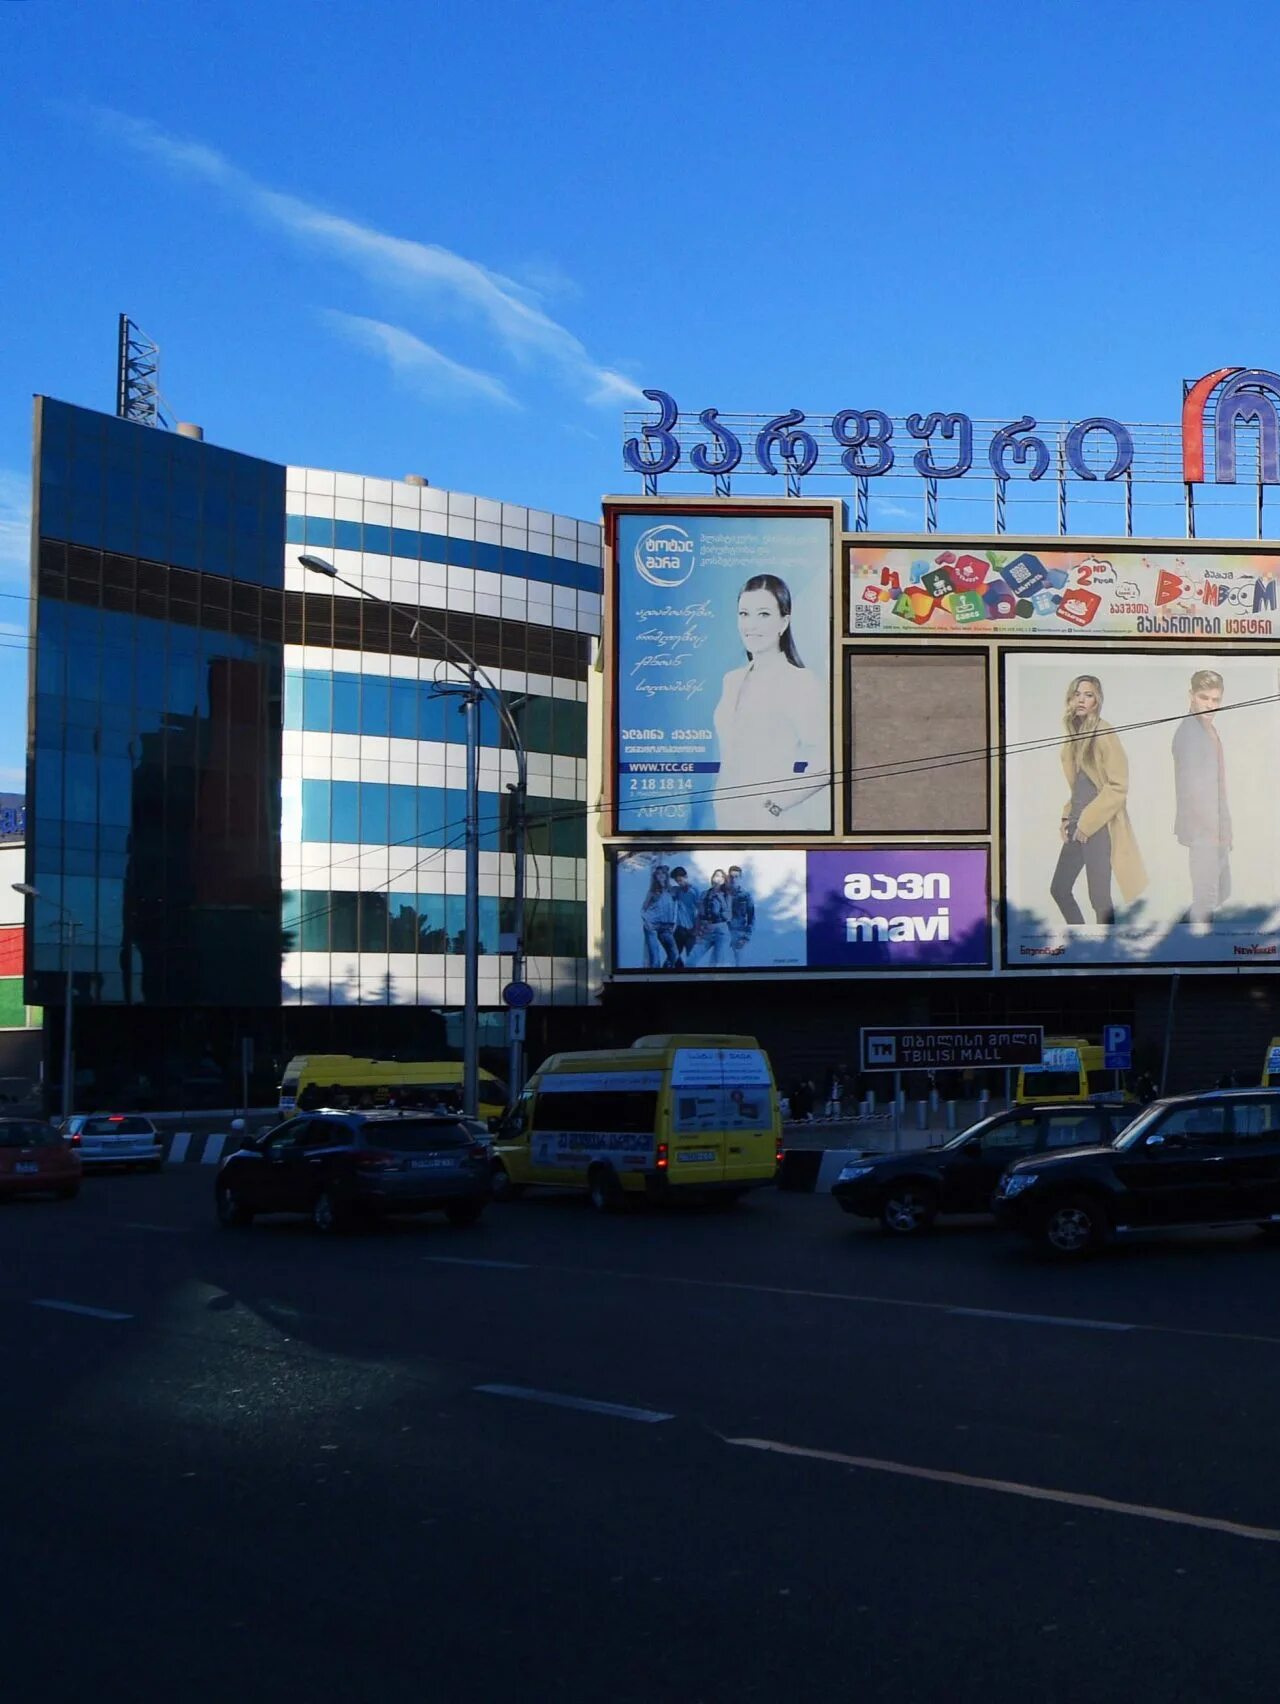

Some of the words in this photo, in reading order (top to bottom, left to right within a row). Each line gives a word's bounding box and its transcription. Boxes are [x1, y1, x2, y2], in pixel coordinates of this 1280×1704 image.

[622, 388, 1135, 482] კარფური
[1225, 618, 1273, 636] ცენტრი
[629, 762, 695, 773] WWW.TCC.GE
[630, 778, 638, 791] 2
[642, 778, 657, 791] 18
[659, 778, 674, 791] 18
[678, 778, 693, 790] 14
[843, 872, 950, 901] მავი
[846, 907, 950, 943] mavi
[901, 1033, 984, 1048] თბილისი
[988, 1033, 1038, 1047] მოლი
[1108, 1028, 1127, 1047] P
[901, 1049, 955, 1063] TBILISI
[961, 1048, 1002, 1062] MALL
